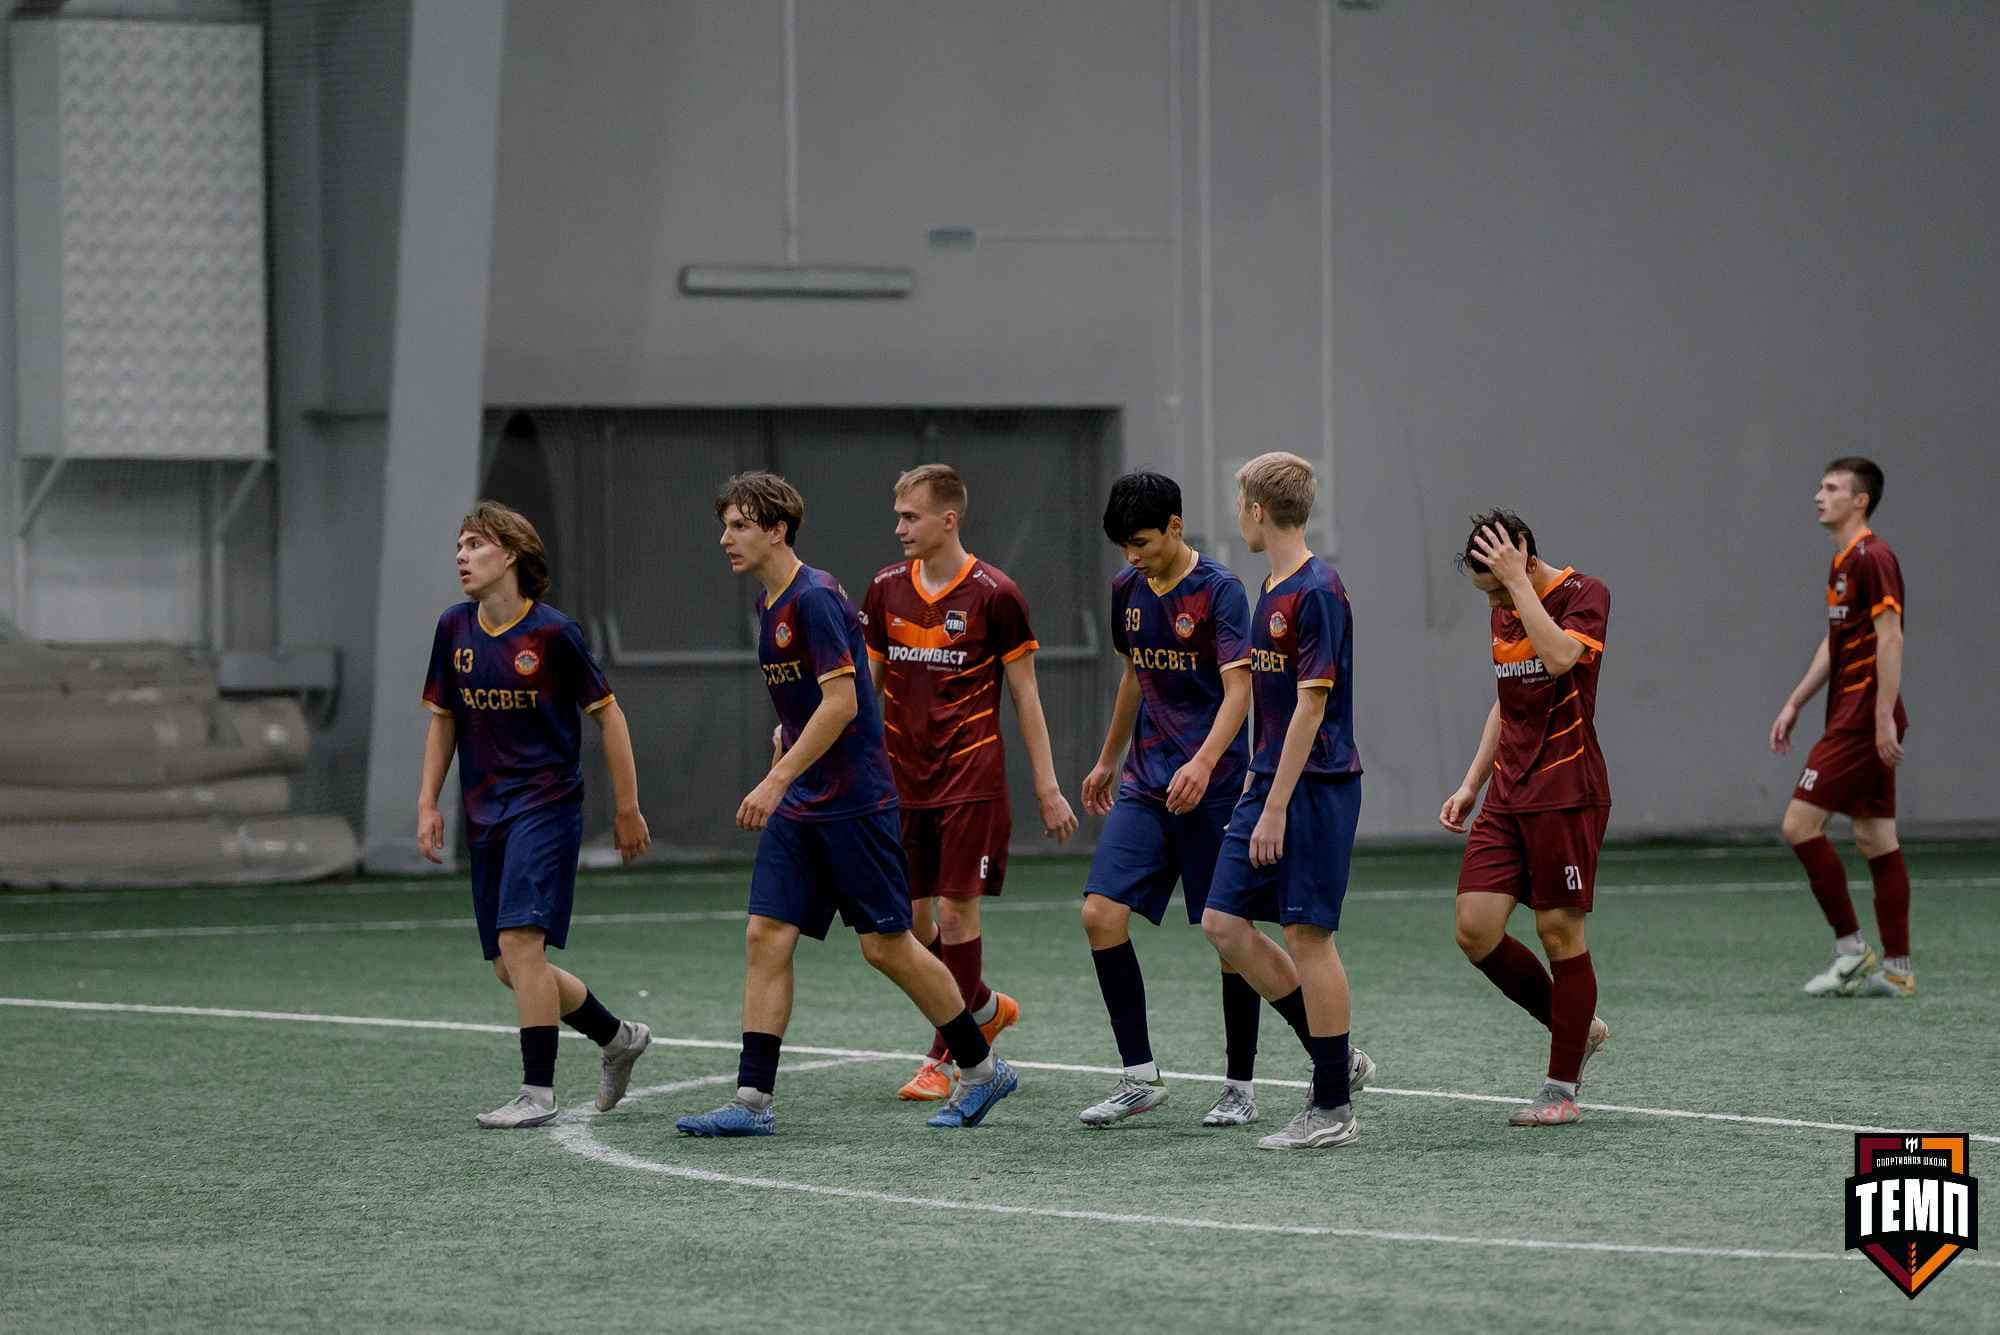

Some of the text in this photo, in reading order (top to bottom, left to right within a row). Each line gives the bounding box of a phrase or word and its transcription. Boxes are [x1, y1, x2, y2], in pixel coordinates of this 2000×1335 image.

[1125, 608, 1140, 631] 39
[1129, 647, 1199, 671] АССВЕТ
[458, 687, 539, 710] АССВЕТ
[979, 855, 989, 879] 6
[1564, 865, 1583, 890] 21
